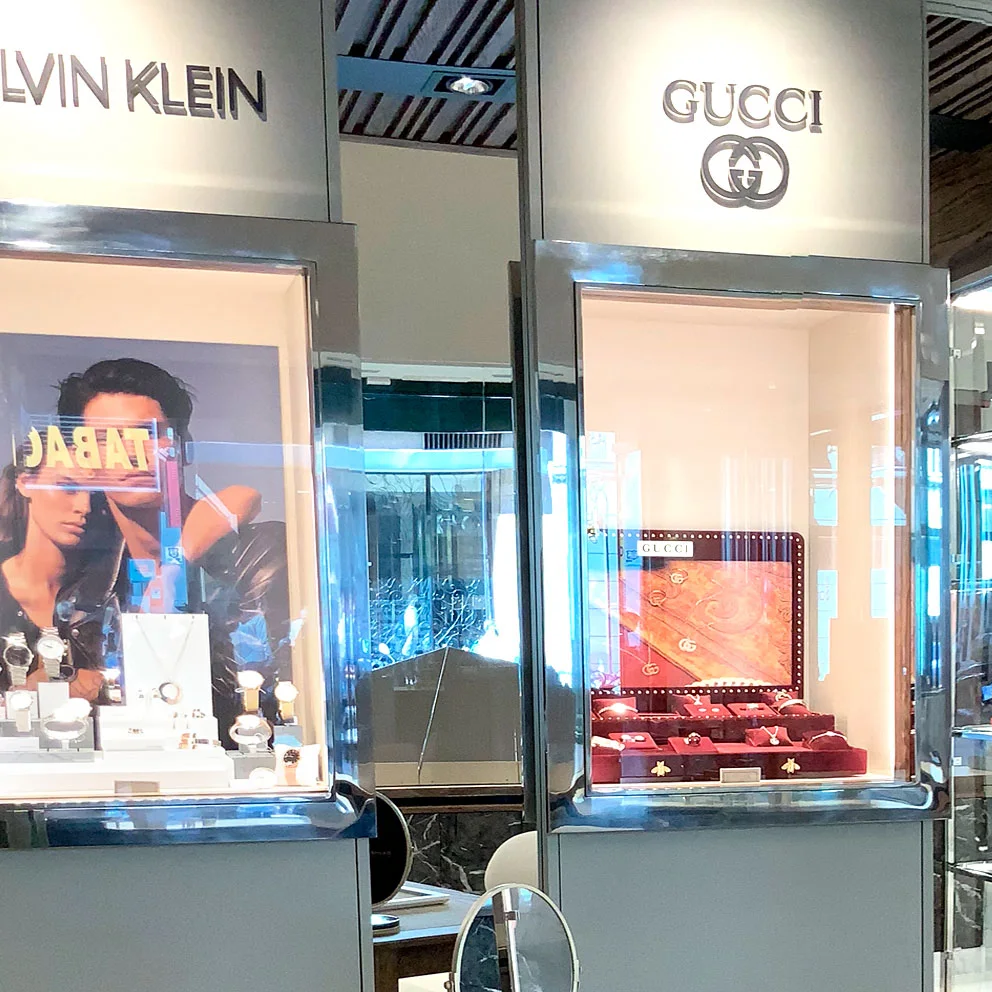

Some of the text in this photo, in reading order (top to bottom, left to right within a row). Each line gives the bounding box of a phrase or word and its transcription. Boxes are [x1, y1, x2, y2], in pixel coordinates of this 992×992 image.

[0, 49, 267, 121] LVIN KLEIN
[663, 79, 823, 133] GUCCI
